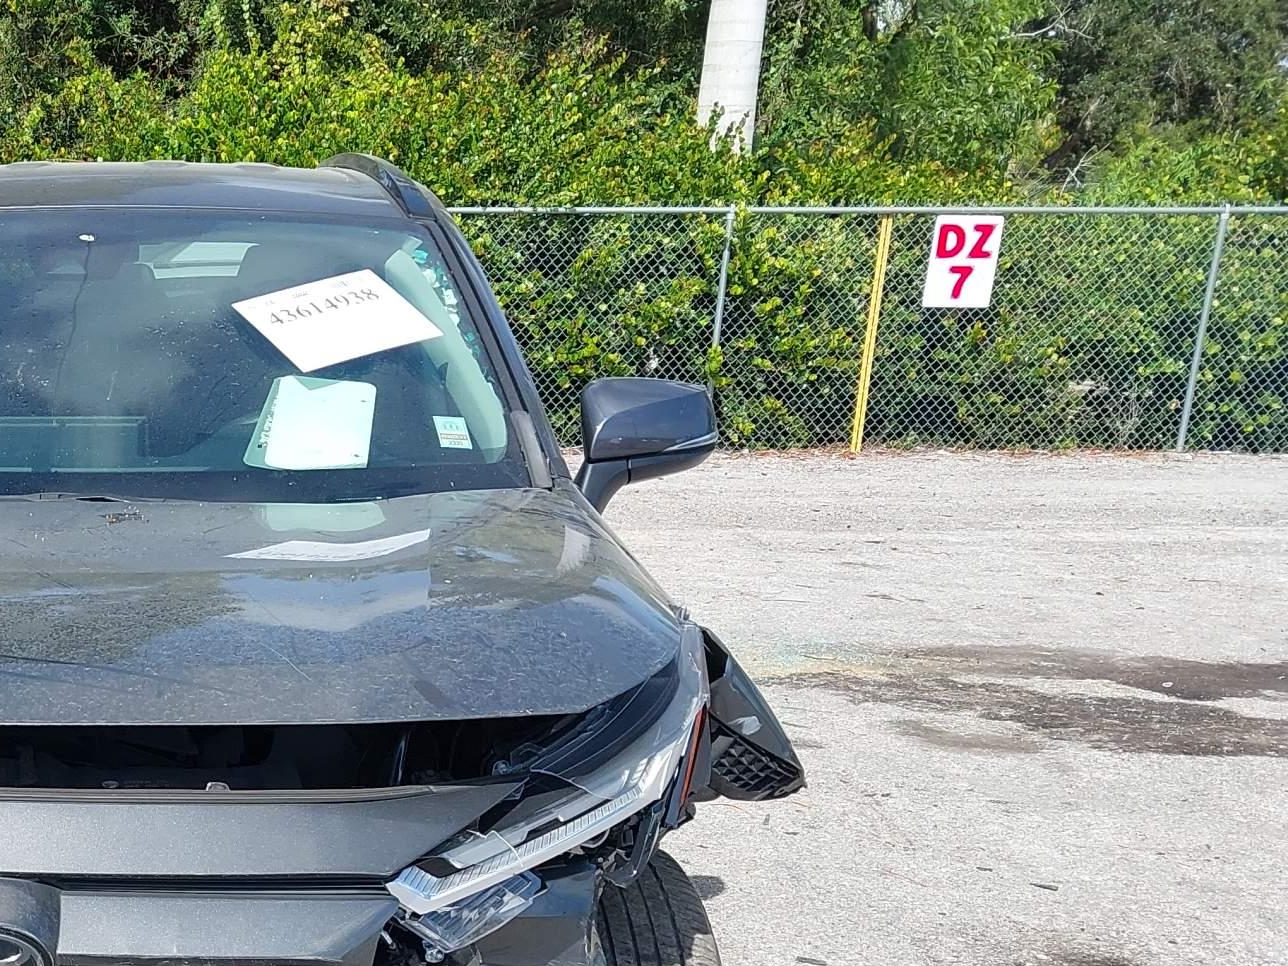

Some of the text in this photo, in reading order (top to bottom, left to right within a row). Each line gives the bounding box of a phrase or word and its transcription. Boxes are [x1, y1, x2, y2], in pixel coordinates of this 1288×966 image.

[936, 224, 997, 258] DZ
[949, 265, 975, 299] 7
[270, 288, 380, 324] 43614938
